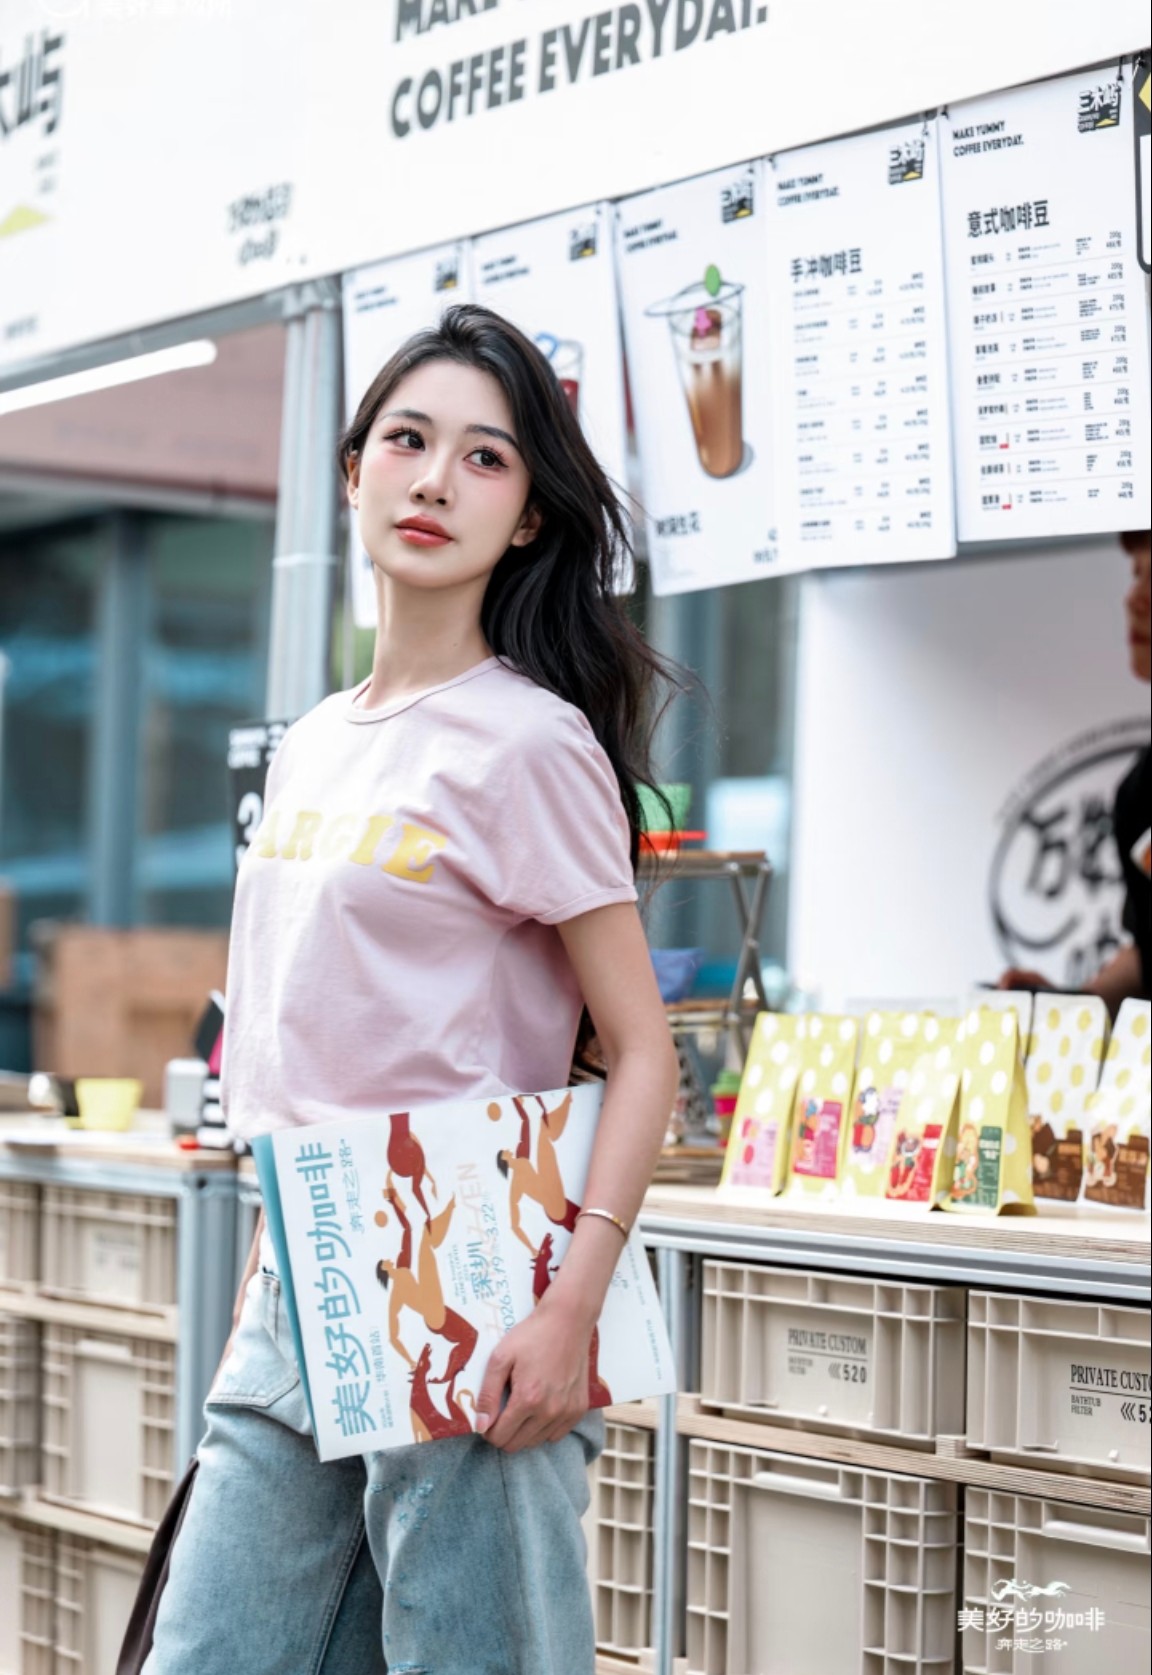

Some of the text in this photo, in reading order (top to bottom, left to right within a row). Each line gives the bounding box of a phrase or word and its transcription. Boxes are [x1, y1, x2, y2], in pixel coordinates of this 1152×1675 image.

[391, 38, 527, 138] COFFEE
[953, 121, 1005, 140] MAKE YUMMY
[953, 142, 981, 157] COFFEE
[967, 200, 1050, 237] 意式咖啡豆
[791, 248, 862, 283] 手冲咖啡豆
[466, 1241, 495, 1299] 深圳
[294, 1142, 377, 1437] 美好的咖啡
[788, 1328, 867, 1355] PRIVATE CUSTOM
[843, 1364, 867, 1384] 520
[1071, 1364, 1151, 1392] PRIVATE CUST
